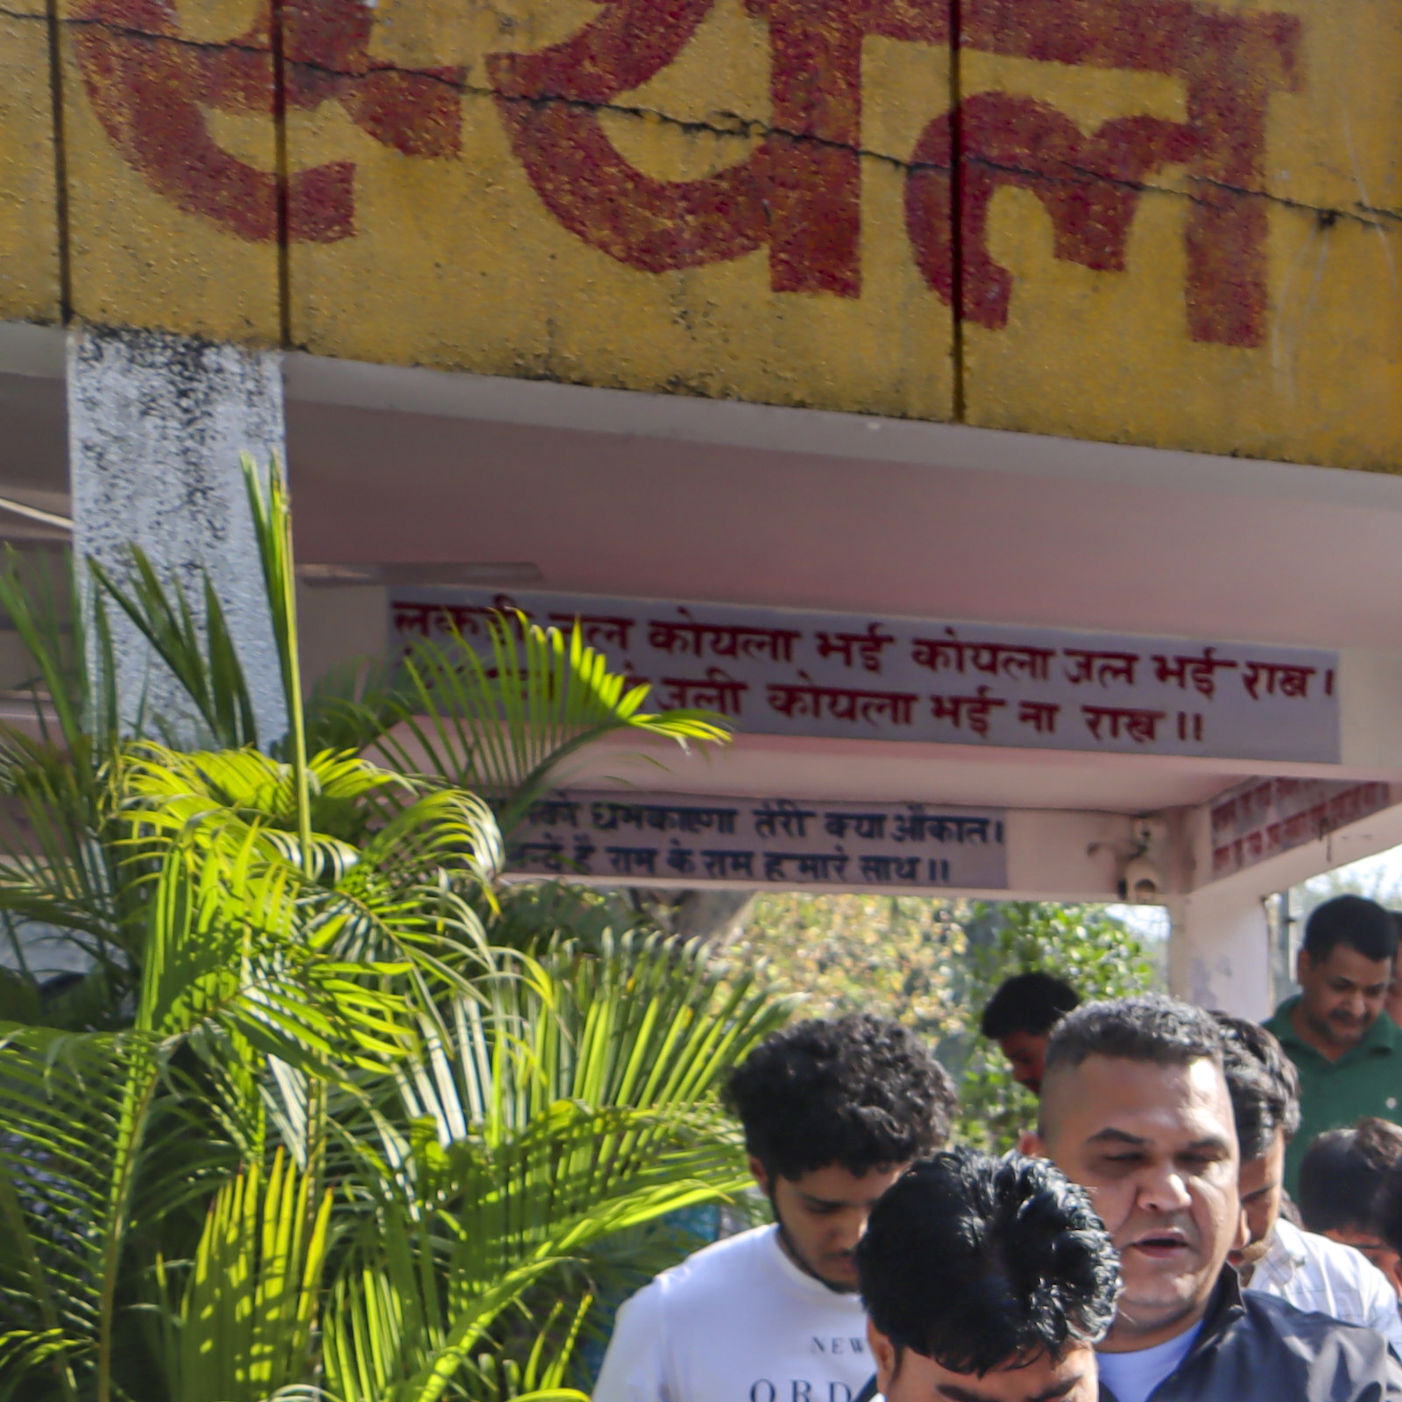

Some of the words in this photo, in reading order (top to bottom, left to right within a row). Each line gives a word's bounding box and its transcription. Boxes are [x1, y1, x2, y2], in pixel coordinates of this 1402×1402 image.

[647, 606, 803, 663] कोयला
[815, 622, 895, 674] भई
[912, 627, 1056, 683] कोयला
[1062, 647, 1140, 688] जल
[1151, 647, 1237, 700] भई
[655, 667, 749, 716] जली
[766, 670, 919, 727] कोयला
[930, 684, 1007, 737] भई
[1018, 699, 1060, 734] ना
[752, 799, 816, 841] तेरी
[604, 846, 658, 876] राम
[700, 850, 755, 880] राम
[811, 1335, 864, 1354] NEW
